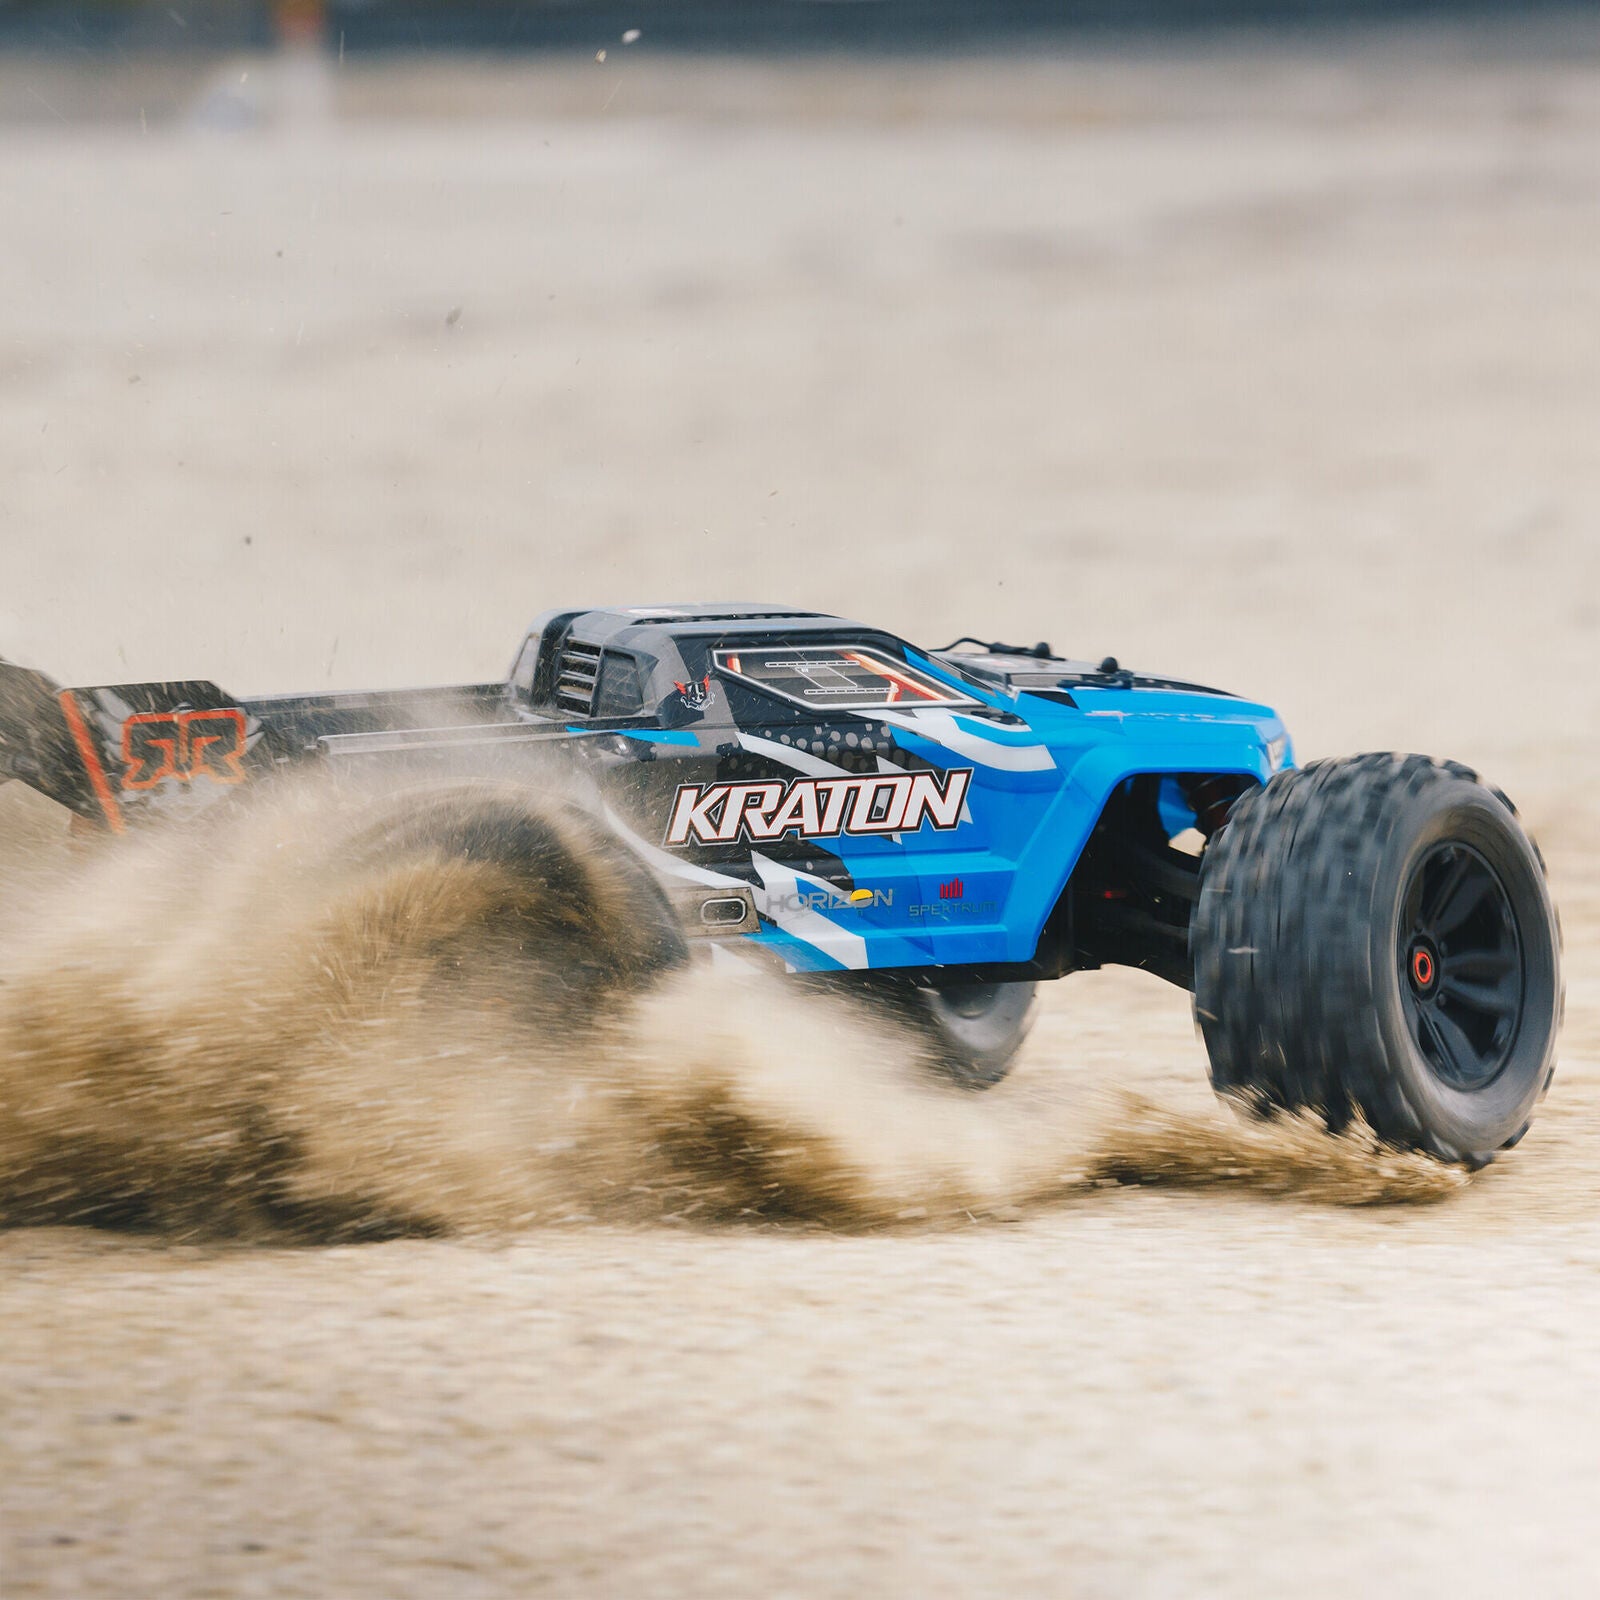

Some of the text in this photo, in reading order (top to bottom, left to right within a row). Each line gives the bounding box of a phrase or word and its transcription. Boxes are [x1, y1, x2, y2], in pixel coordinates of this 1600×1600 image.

[664, 768, 973, 847] KRATON
[766, 888, 893, 913] HORIZON
[908, 901, 998, 917] SPEKTRUM
